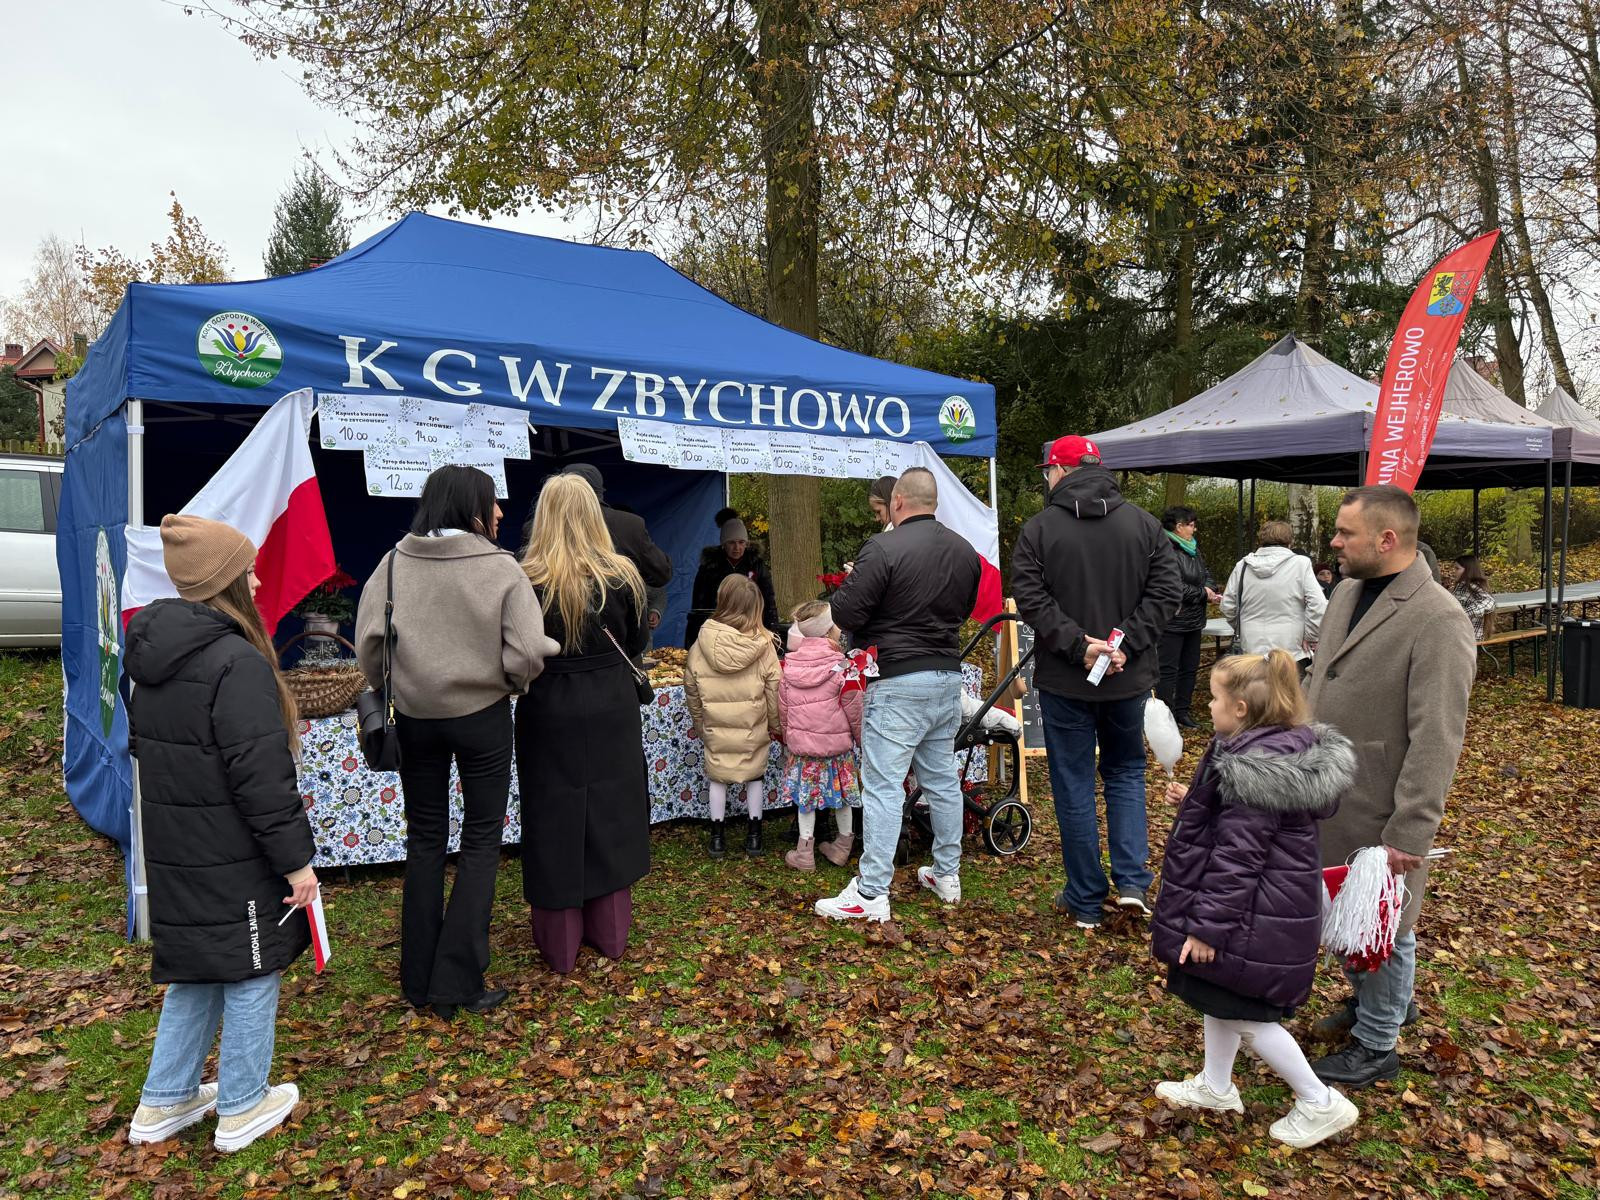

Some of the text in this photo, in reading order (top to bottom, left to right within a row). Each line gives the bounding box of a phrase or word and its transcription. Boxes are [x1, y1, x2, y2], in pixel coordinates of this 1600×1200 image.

[201, 313, 277, 347] KOŁO GOSPODYN WIEJSKICH
[213, 360, 272, 382] Zbychowo
[1384, 327, 1425, 442] WEJHEROWO
[591, 366, 911, 438] ZBYCHOWO
[250, 931, 262, 970] THOUGHT
